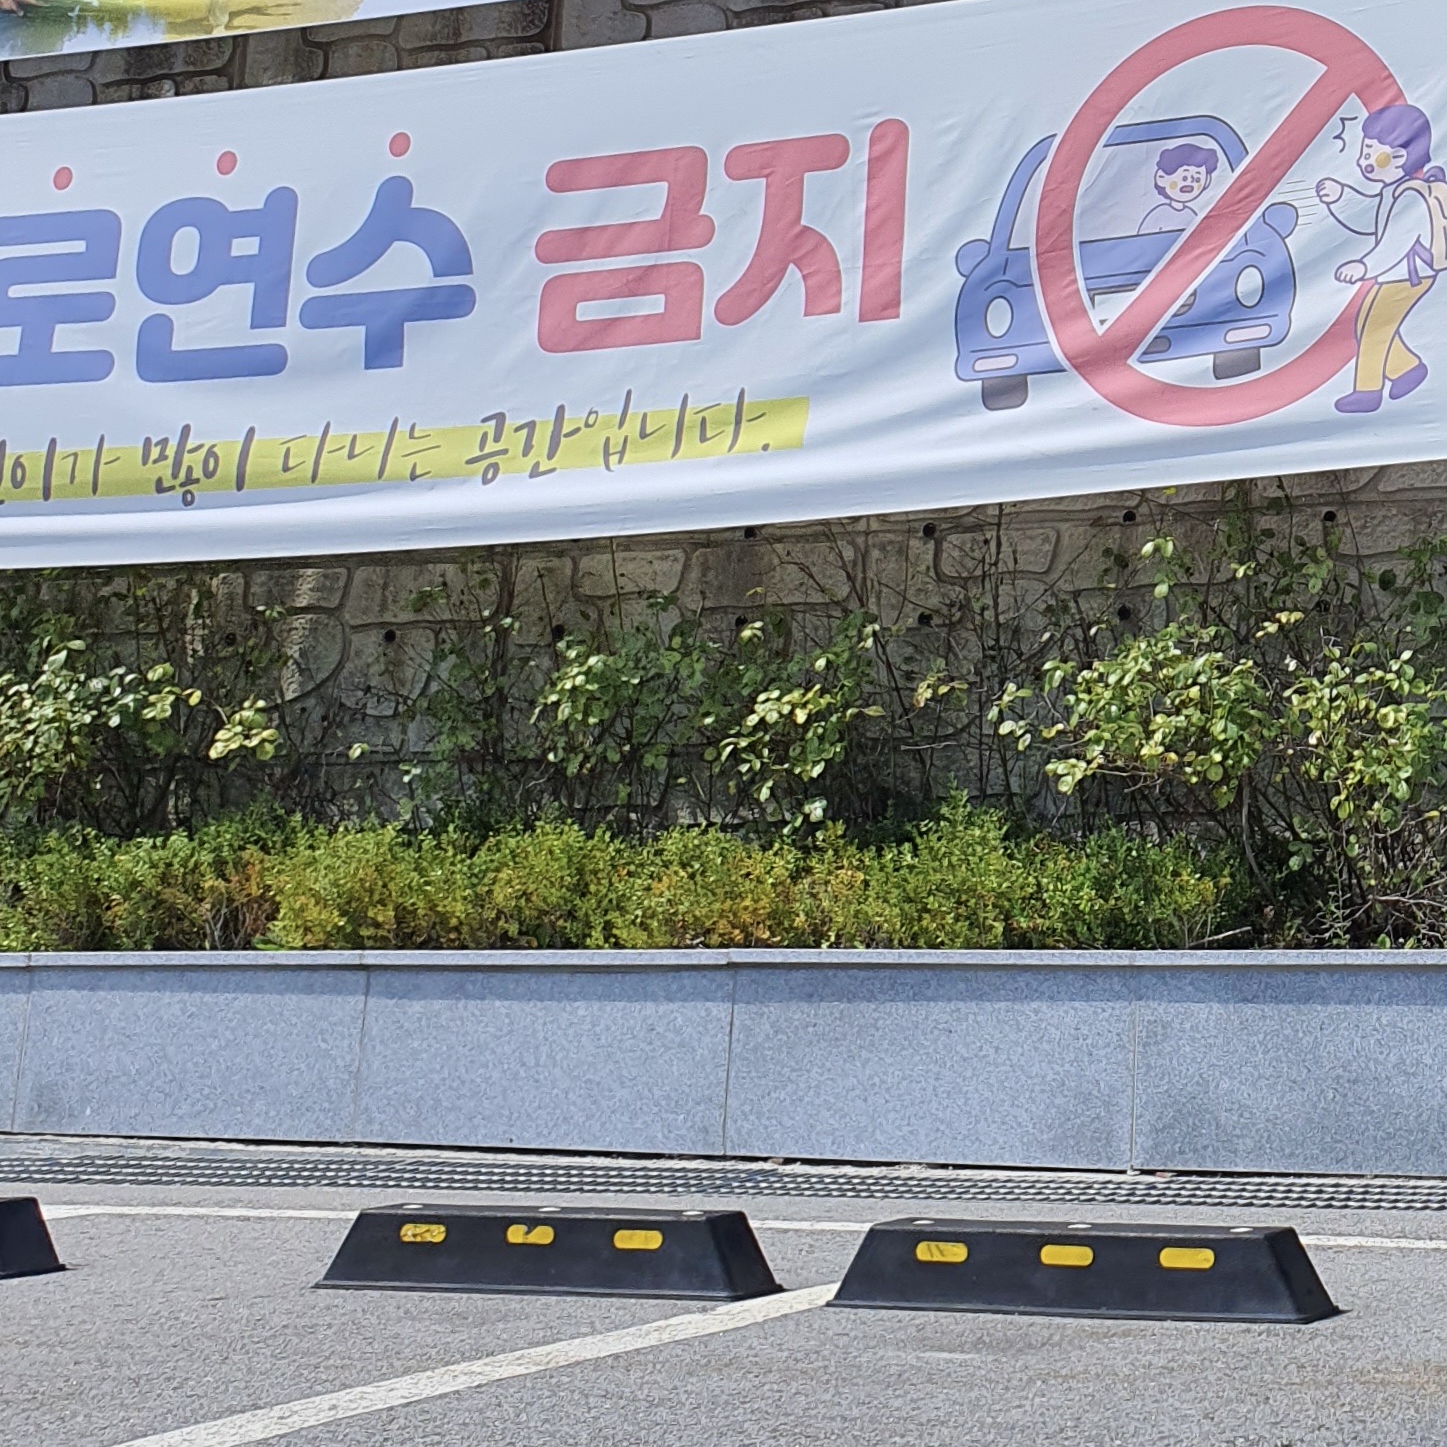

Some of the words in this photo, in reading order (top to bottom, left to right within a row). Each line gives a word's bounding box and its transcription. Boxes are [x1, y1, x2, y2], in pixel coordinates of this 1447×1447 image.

[534, 117, 910, 356] 금지
[0, 432, 122, 506] 이가
[141, 422, 256, 508] 많이
[280, 415, 443, 484] 다니는
